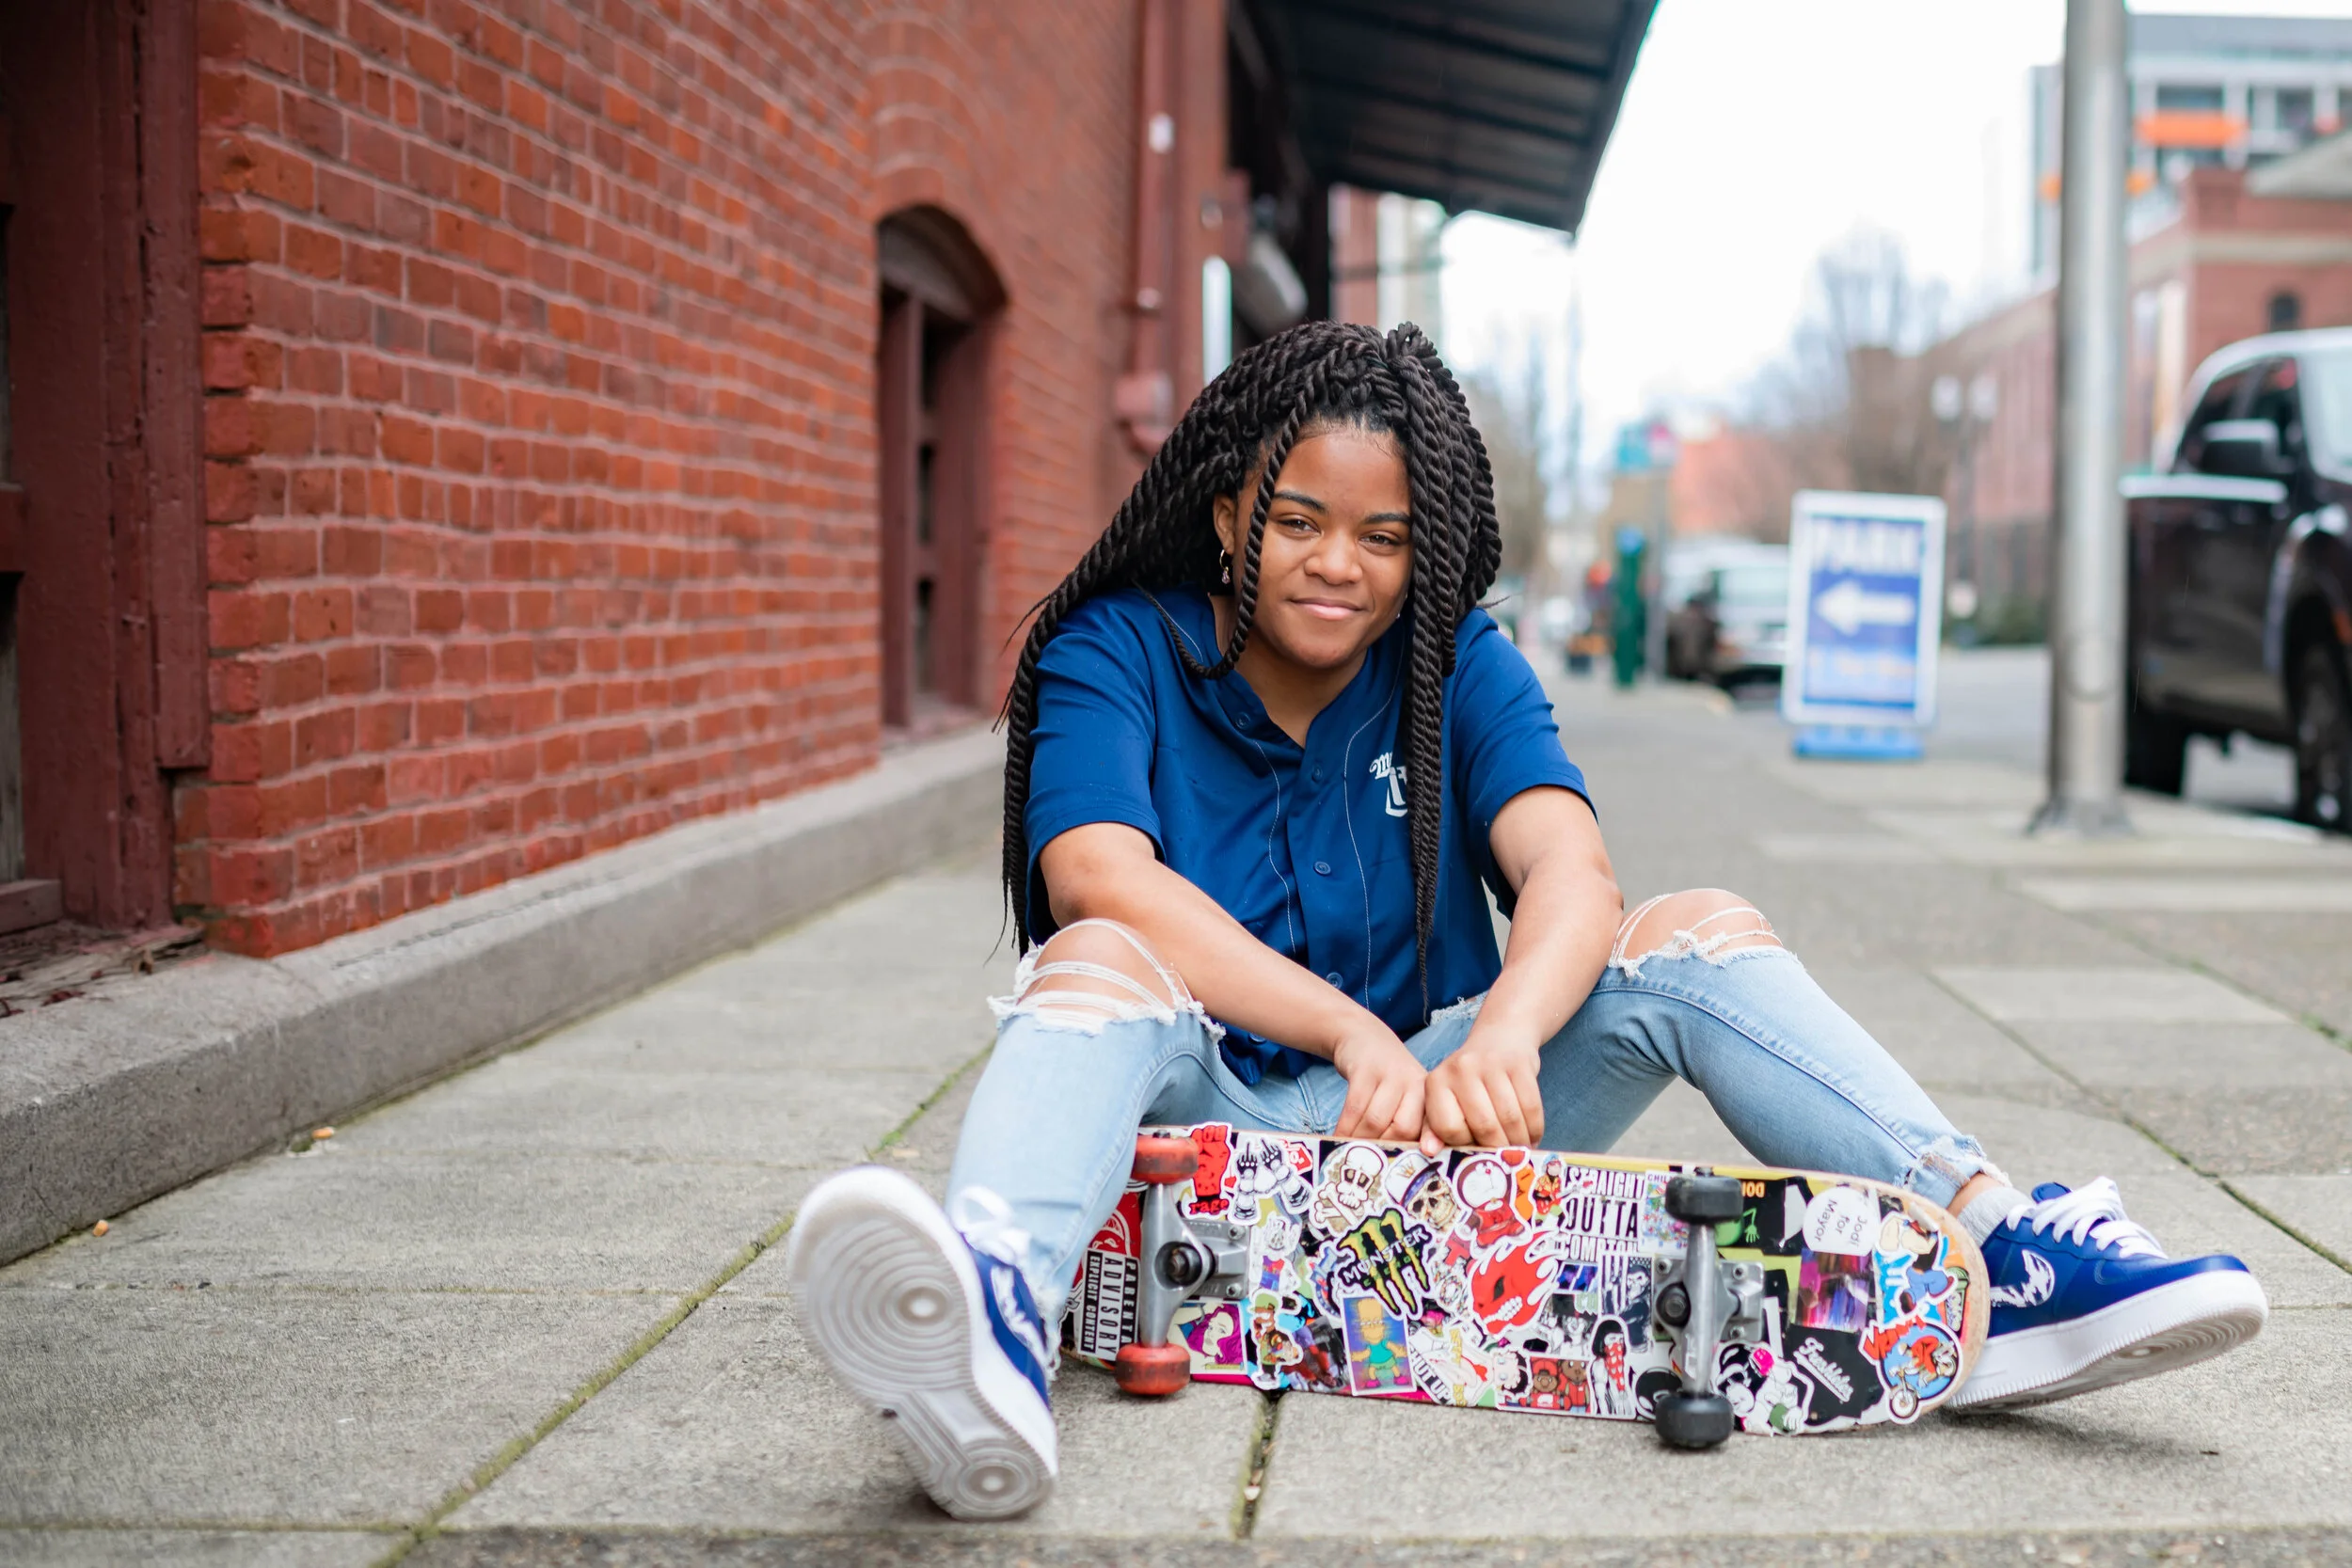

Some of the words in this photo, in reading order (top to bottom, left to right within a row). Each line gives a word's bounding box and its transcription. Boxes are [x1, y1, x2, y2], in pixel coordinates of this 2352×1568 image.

[1189, 1198, 1230, 1215] rage
[1565, 1196, 1638, 1238] OUTTA
[1814, 1198, 1837, 1242] Mayor
[1835, 1214, 1851, 1234] for
[1851, 1215, 1868, 1247] Jodi
[1342, 1227, 1429, 1284] MONSTER
[1087, 1256, 1101, 1301] EXPLICIT
[1098, 1258, 1122, 1354] ADVISORY
[1120, 1261, 1136, 1343] PARENTA
[1083, 1305, 1097, 1350] CONTENT
